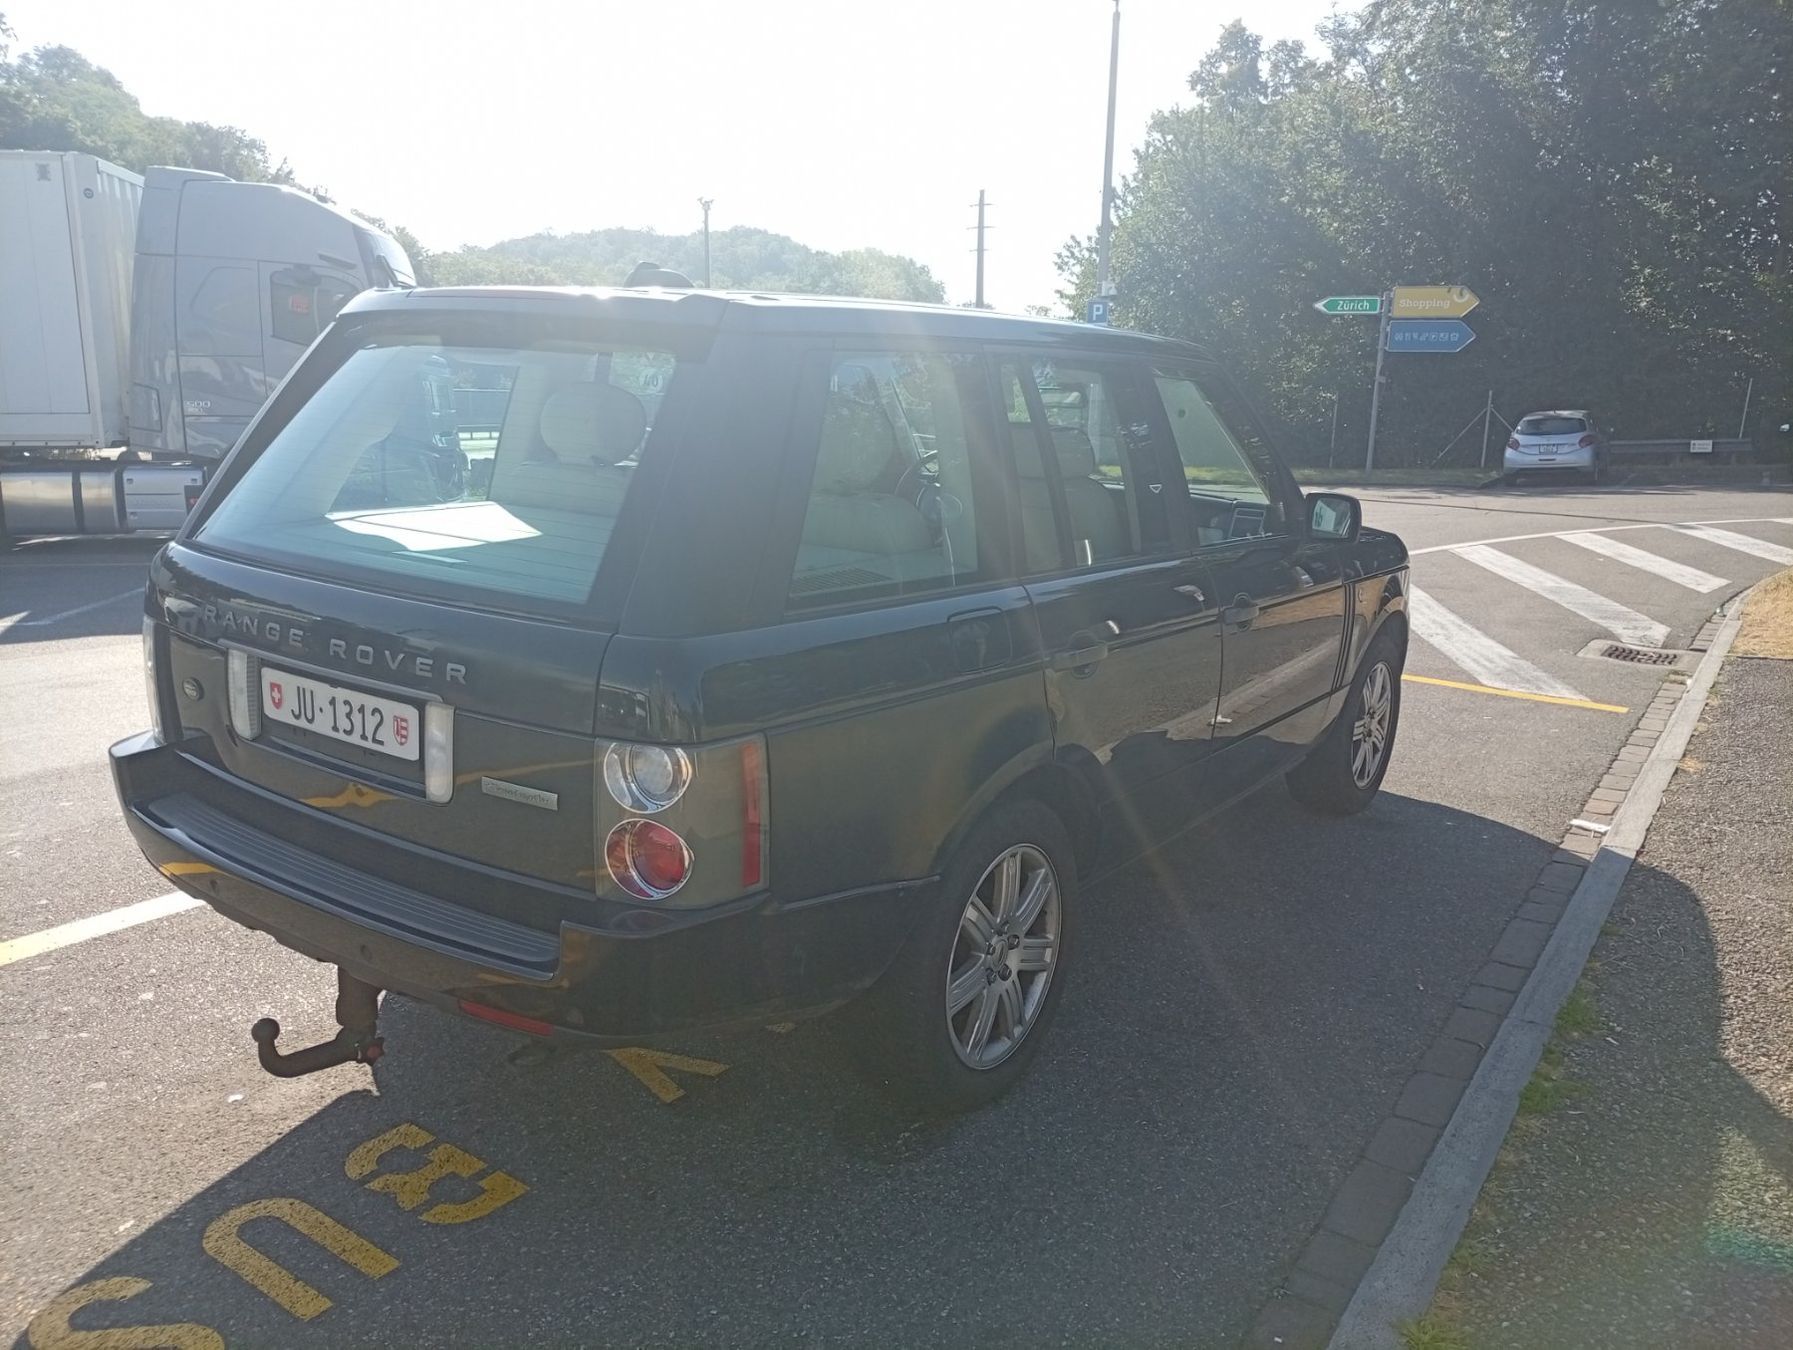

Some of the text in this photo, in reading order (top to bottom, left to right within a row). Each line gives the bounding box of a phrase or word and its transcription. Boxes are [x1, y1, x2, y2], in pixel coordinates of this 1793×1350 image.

[1337, 299, 1370, 311] Zürich
[1399, 299, 1450, 309] Shopping
[1092, 303, 1104, 321] P
[204, 605, 467, 684] RANGE ROVER
